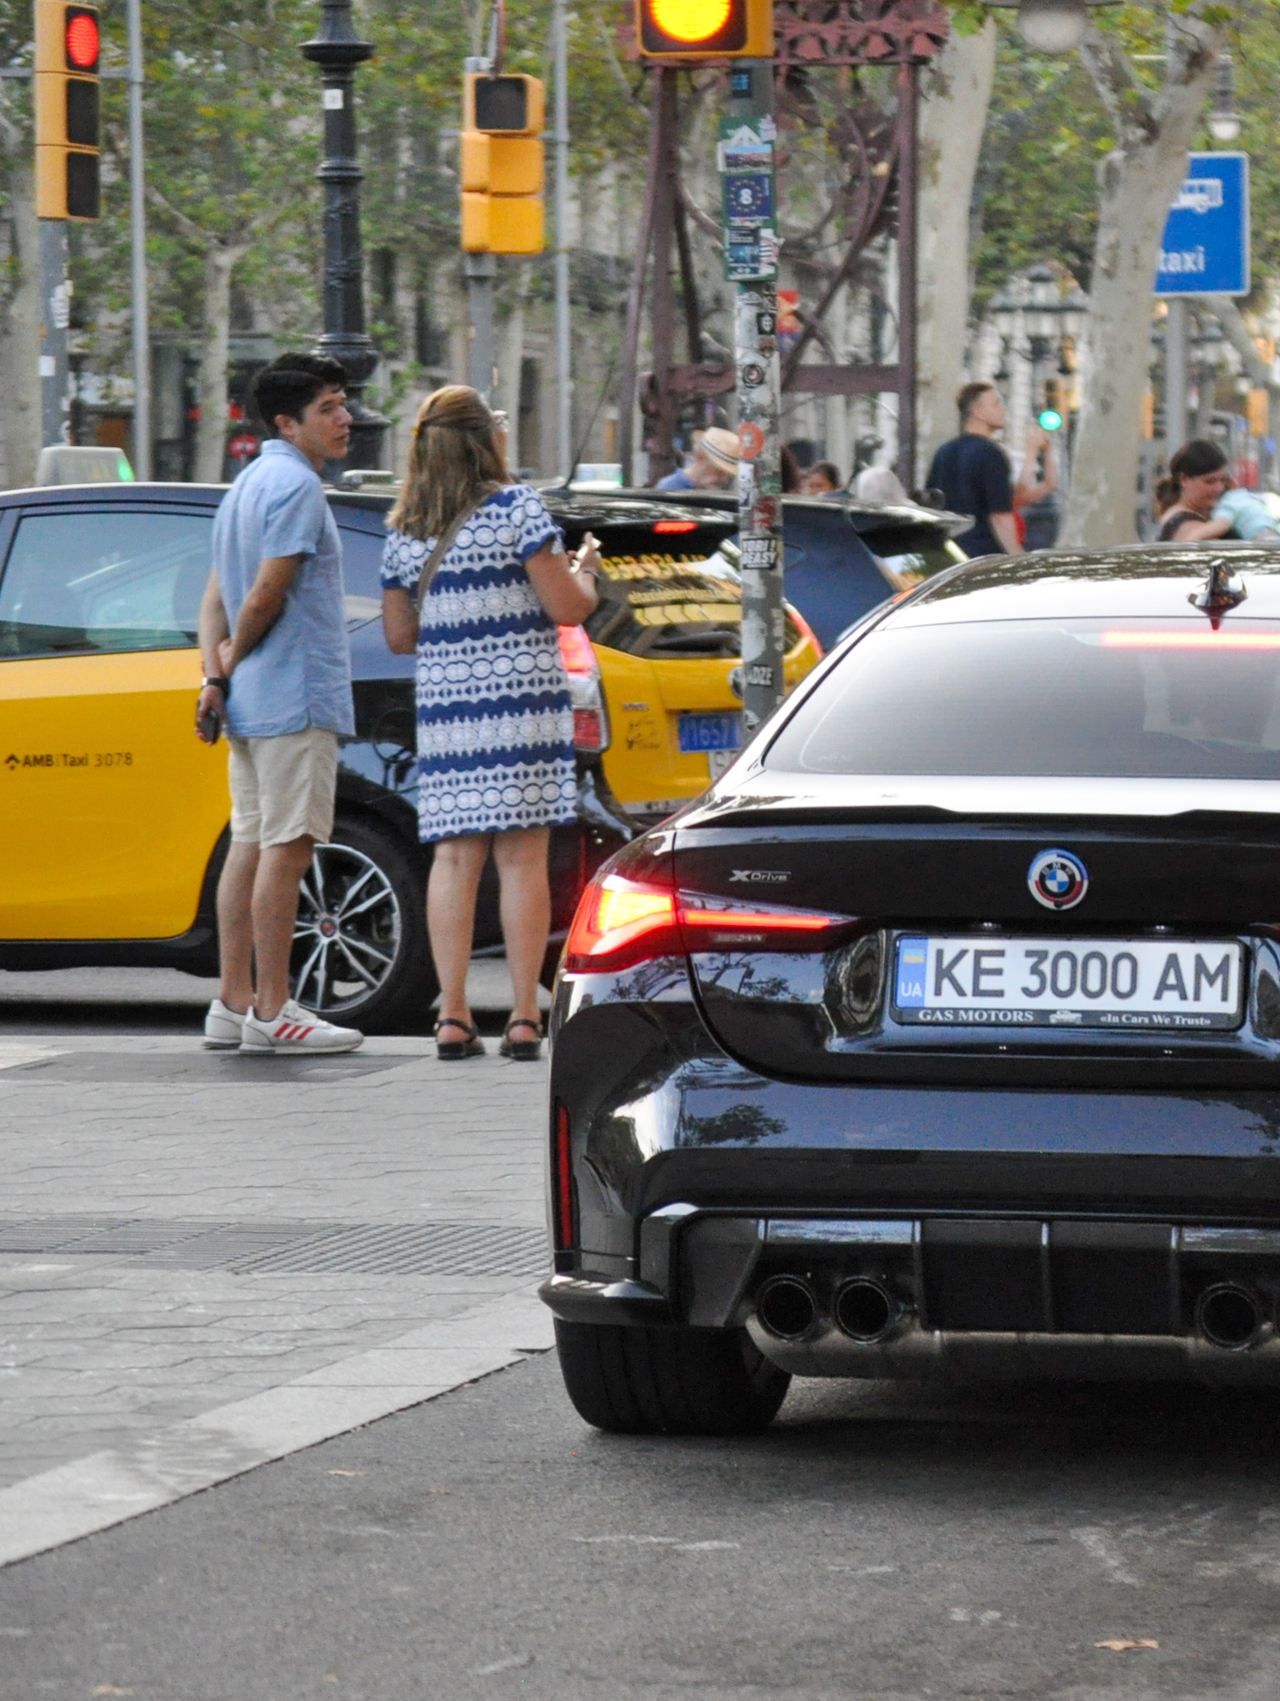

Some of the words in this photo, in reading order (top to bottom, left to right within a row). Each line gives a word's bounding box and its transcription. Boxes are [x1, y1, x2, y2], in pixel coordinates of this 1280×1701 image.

[23, 754, 54, 767] AMB
[62, 753, 89, 767] Taxi
[94, 752, 133, 768] 3078
[934, 948, 1006, 999] KE
[1020, 949, 1138, 1000] 3000
[1152, 953, 1231, 1002] AM
[901, 981, 923, 999] UA
[918, 1009, 954, 1022] GAS
[957, 1009, 1034, 1023] MOTORS
[1122, 1013, 1150, 1025] Cars
[1152, 1014, 1171, 1025] We
